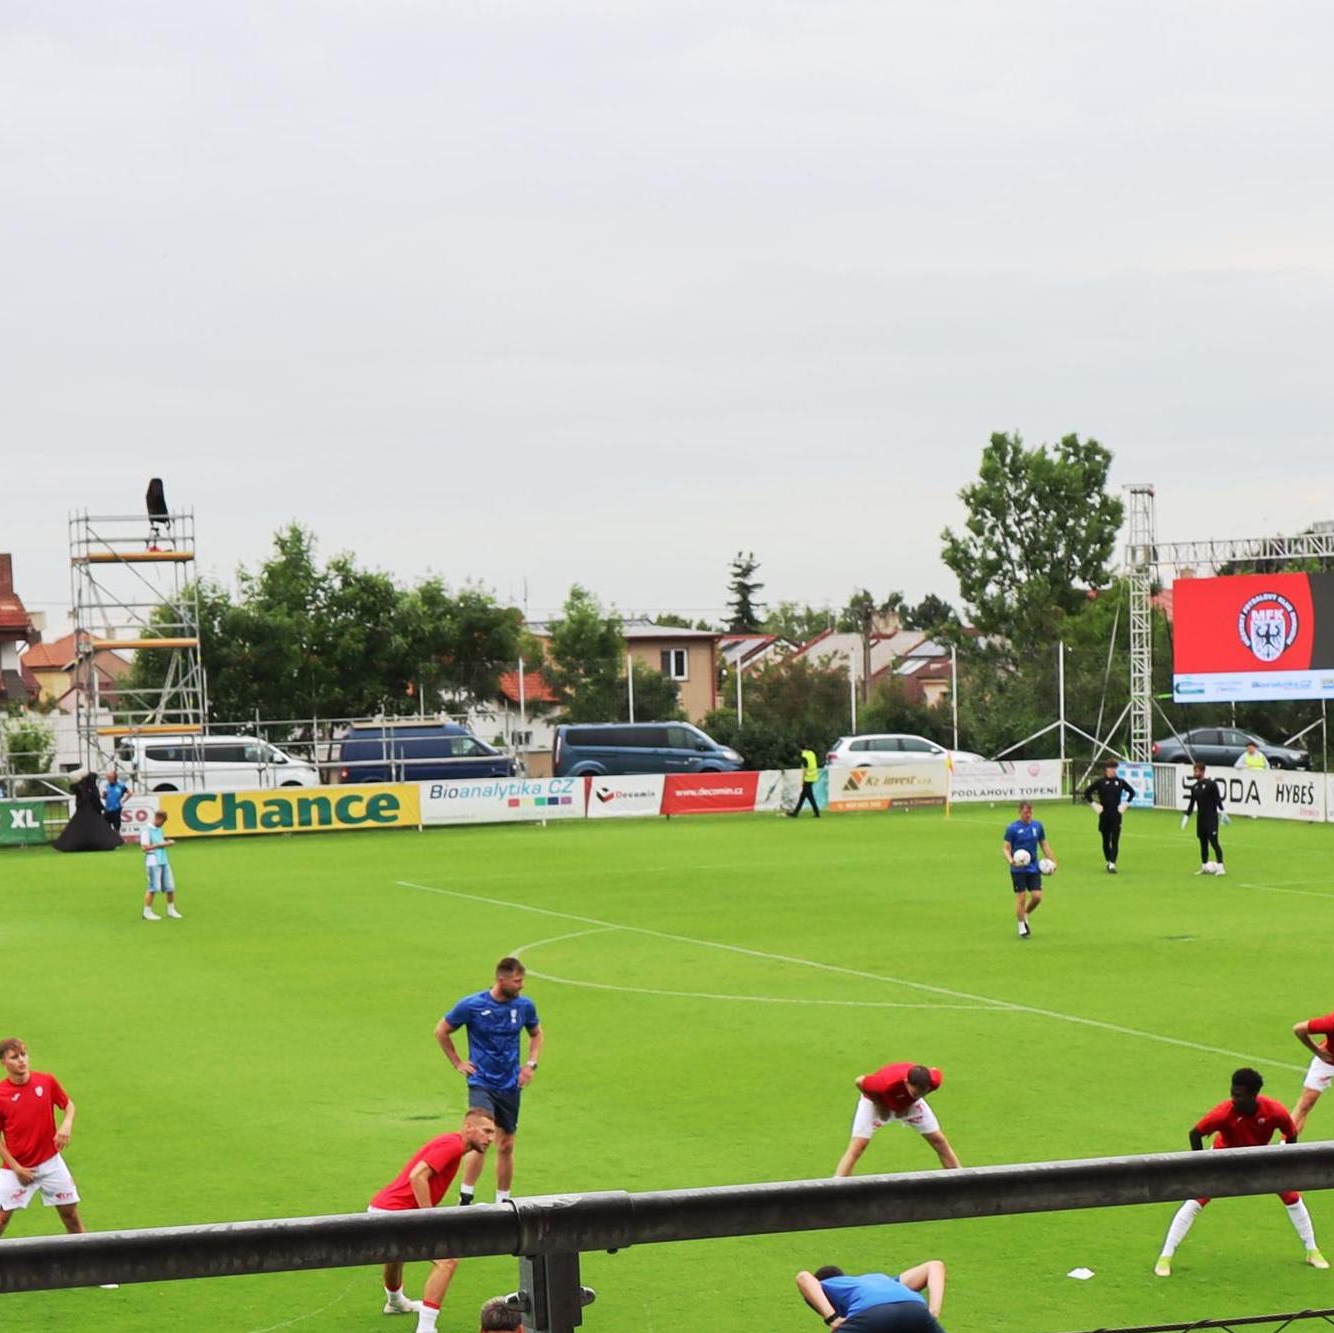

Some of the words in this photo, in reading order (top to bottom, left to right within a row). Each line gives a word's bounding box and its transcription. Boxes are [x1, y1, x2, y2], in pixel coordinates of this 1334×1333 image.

[1251, 608, 1284, 621] MFK
[430, 781, 542, 800] Bioanalytika
[549, 778, 576, 794] CZ
[883, 775, 917, 786] invest
[1182, 776, 1261, 805] ŠODA
[675, 787, 744, 798] www.decomin.cz
[1018, 786, 1058, 797] TOPENÍ
[1275, 782, 1315, 805] HYBEŠ
[10, 808, 40, 829] XL
[181, 791, 401, 833] Chance
